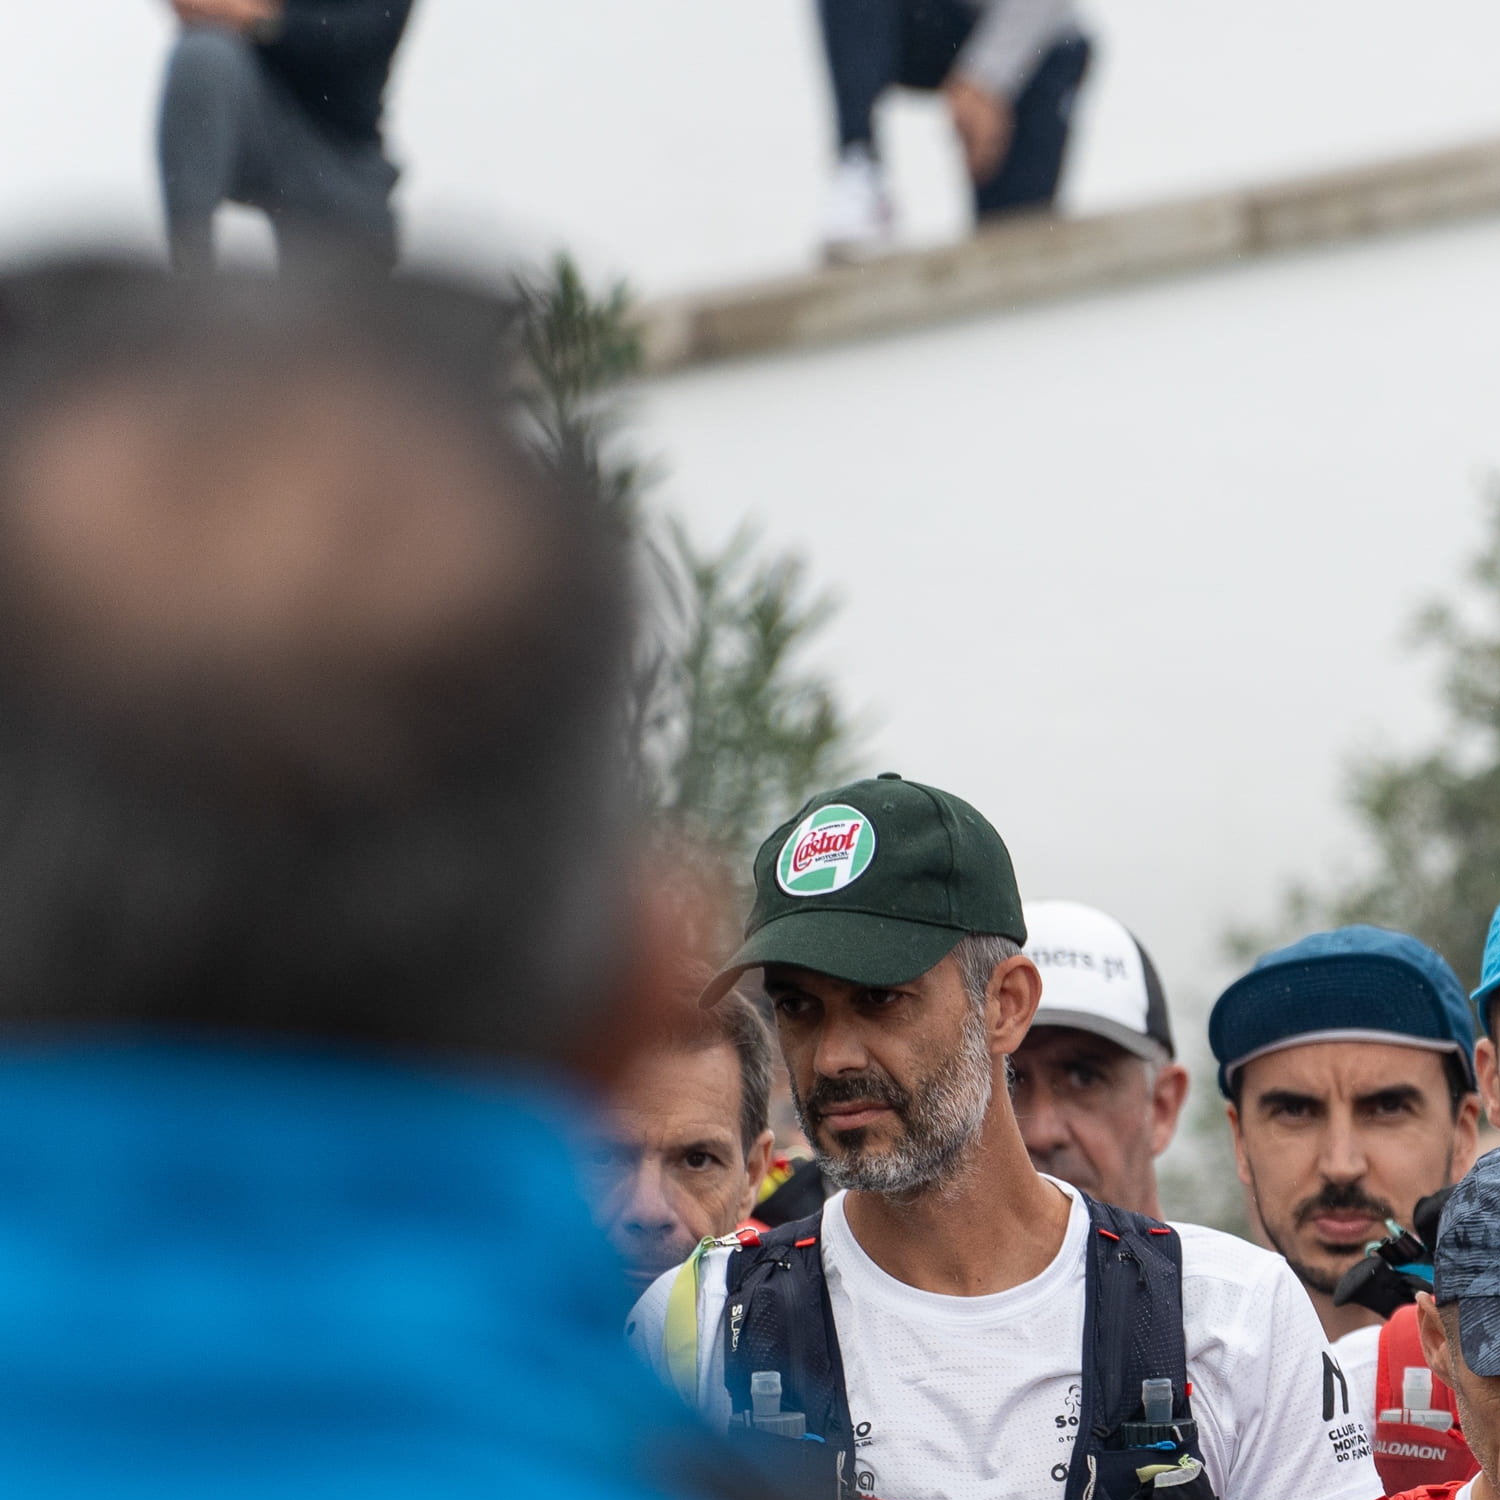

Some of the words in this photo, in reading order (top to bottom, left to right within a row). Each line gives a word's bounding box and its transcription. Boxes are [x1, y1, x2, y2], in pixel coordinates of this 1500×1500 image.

[793, 823, 860, 873] Castrol
[1026, 944, 1128, 982] ners.pt
[1328, 1423, 1356, 1441] CLUBE
[1336, 1453, 1350, 1463] DO
